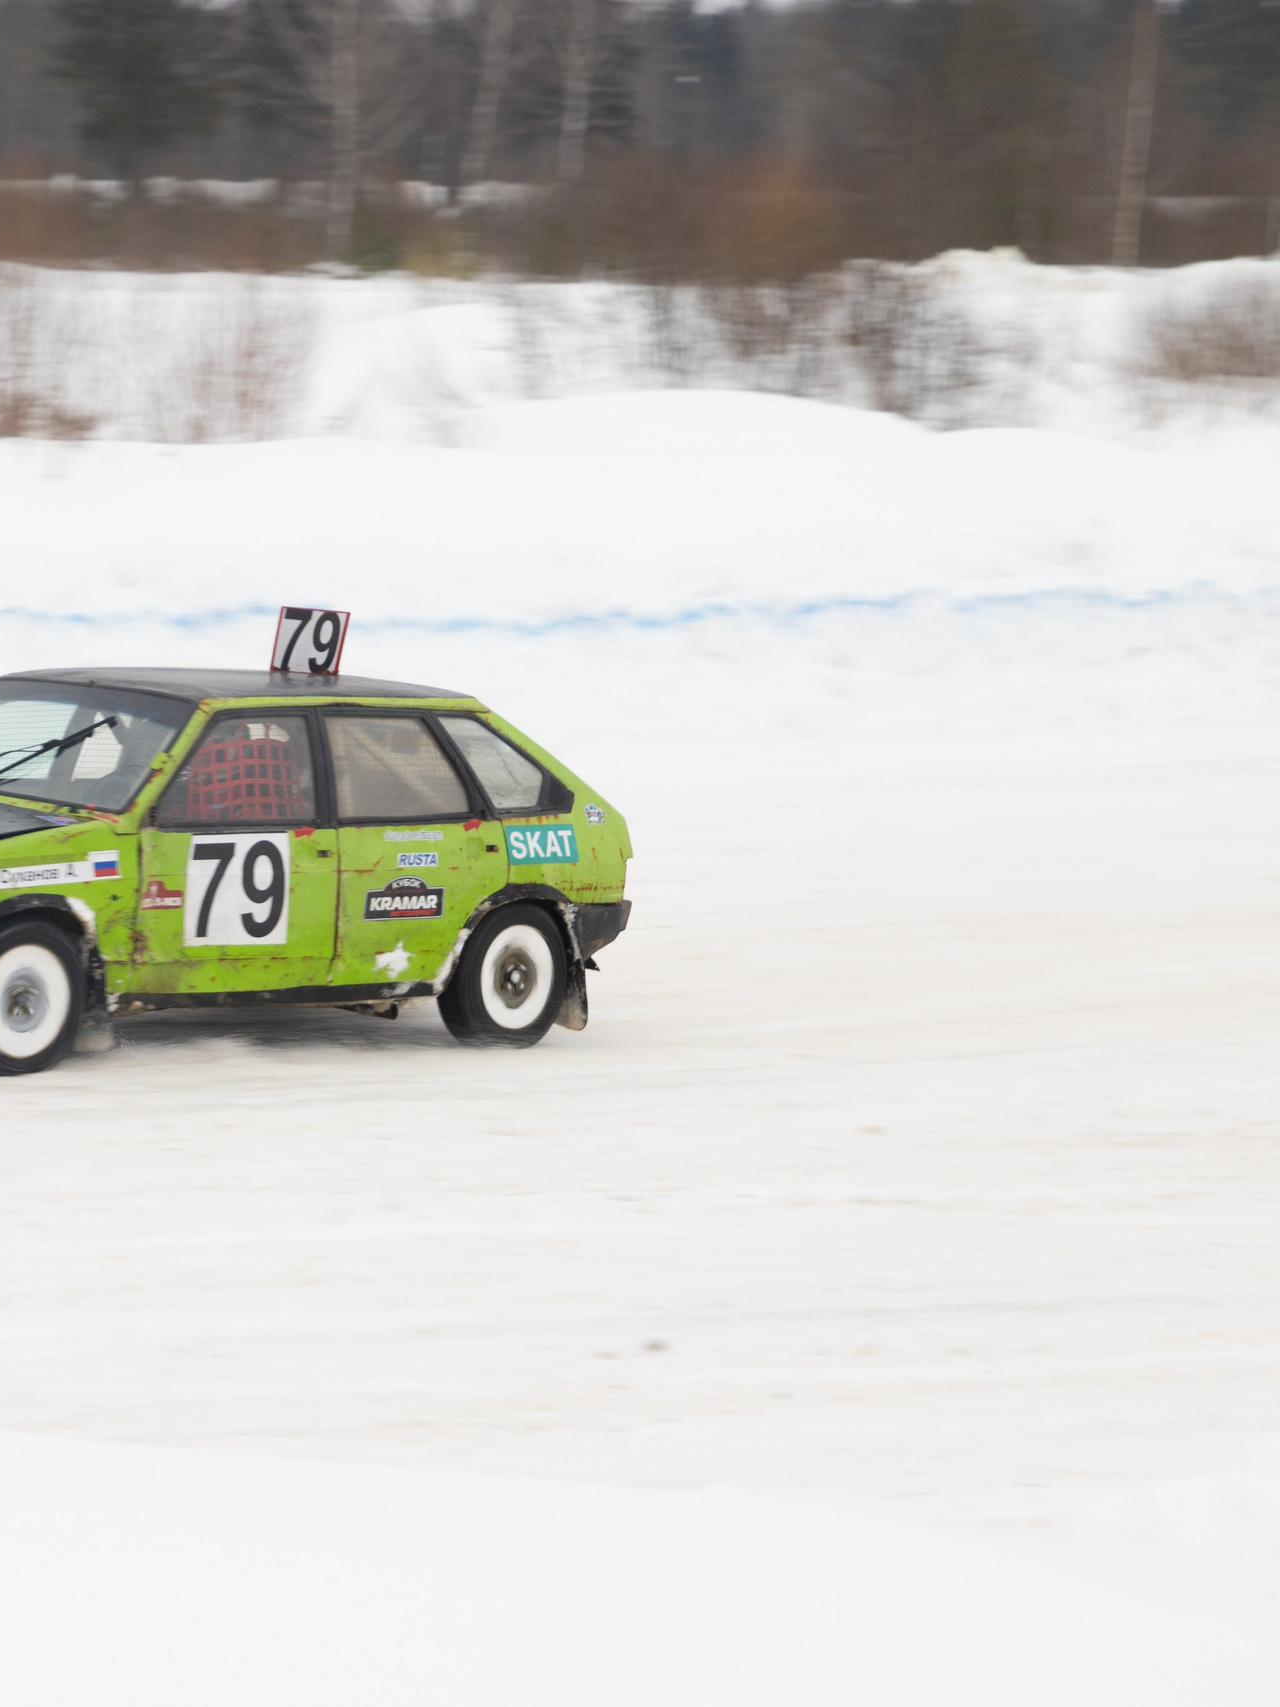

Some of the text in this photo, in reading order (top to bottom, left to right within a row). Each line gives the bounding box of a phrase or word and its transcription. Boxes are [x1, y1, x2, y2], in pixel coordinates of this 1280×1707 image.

[280, 608, 340, 674] 79
[509, 830, 572, 859] SKAT
[398, 854, 437, 866] RUSTA
[192, 840, 286, 938] 79
[369, 895, 438, 911] KRAMAR
